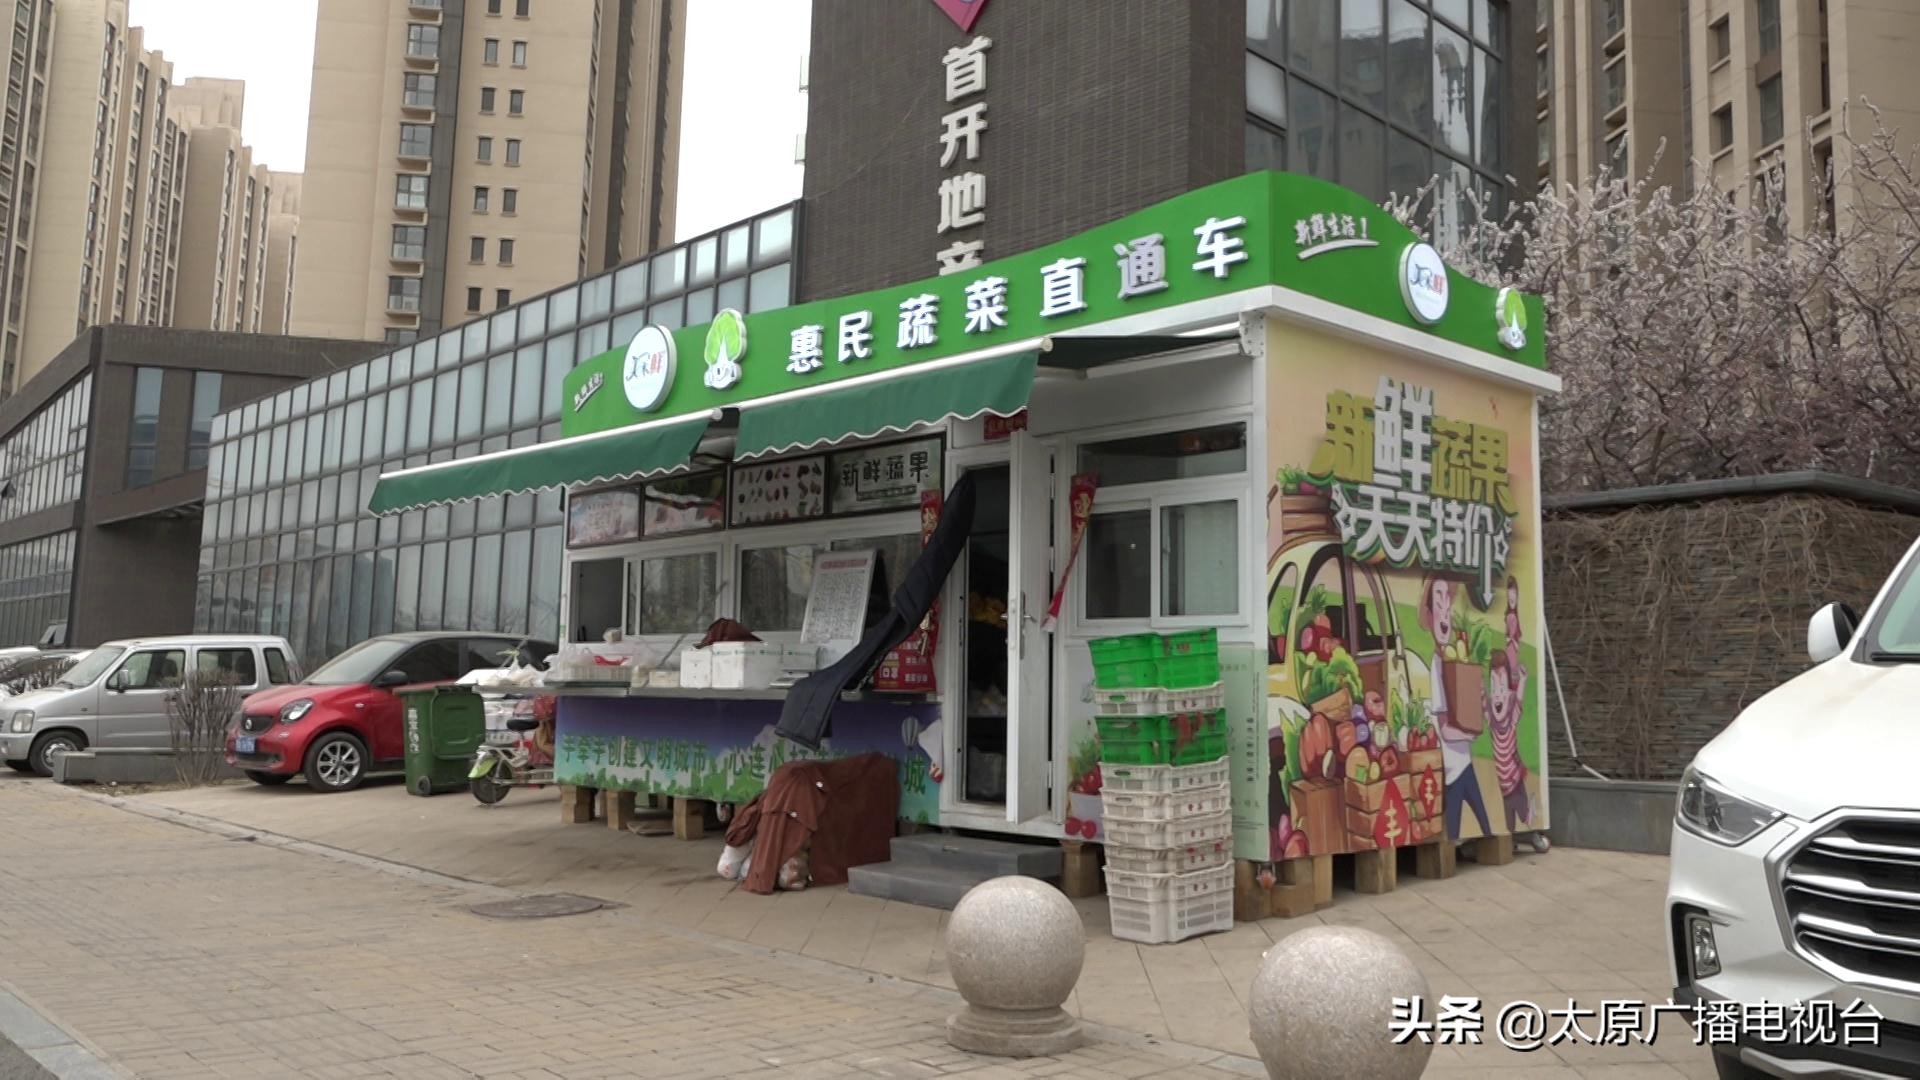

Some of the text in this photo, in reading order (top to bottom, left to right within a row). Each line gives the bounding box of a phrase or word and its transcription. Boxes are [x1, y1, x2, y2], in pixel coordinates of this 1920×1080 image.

[937, 35, 993, 275] 首开地产
[783, 215, 1249, 374] 惠民蔬菜直通车
[841, 451, 930, 492] 新鲜蔬果
[1347, 483, 1496, 606] 天天特价
